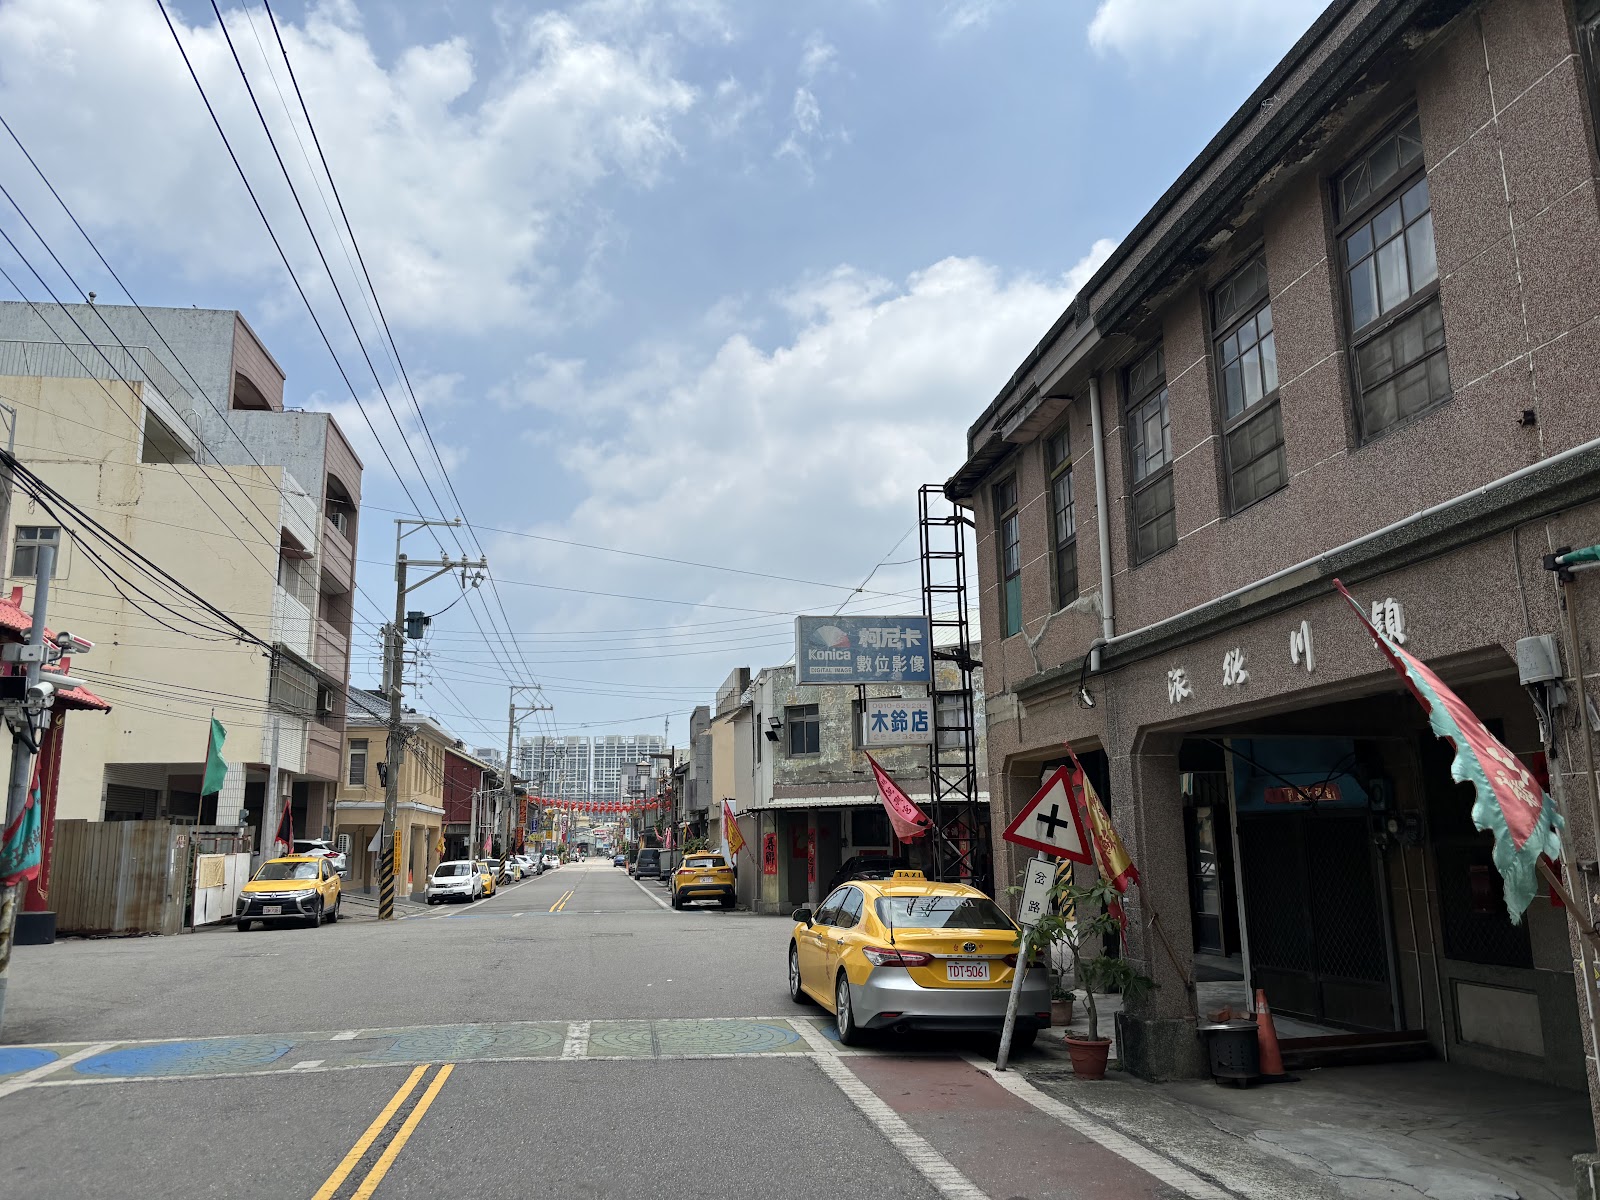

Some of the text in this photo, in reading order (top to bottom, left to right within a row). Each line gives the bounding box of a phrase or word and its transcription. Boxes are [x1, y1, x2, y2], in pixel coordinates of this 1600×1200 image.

[859, 627, 922, 648] 柯尼卡
[808, 648, 851, 660] Konica
[856, 655, 925, 673] 數位影像
[871, 709, 929, 732] 木鈴店
[1028, 871, 1047, 914] 公路
[947, 965, 988, 978] TDT-5061
